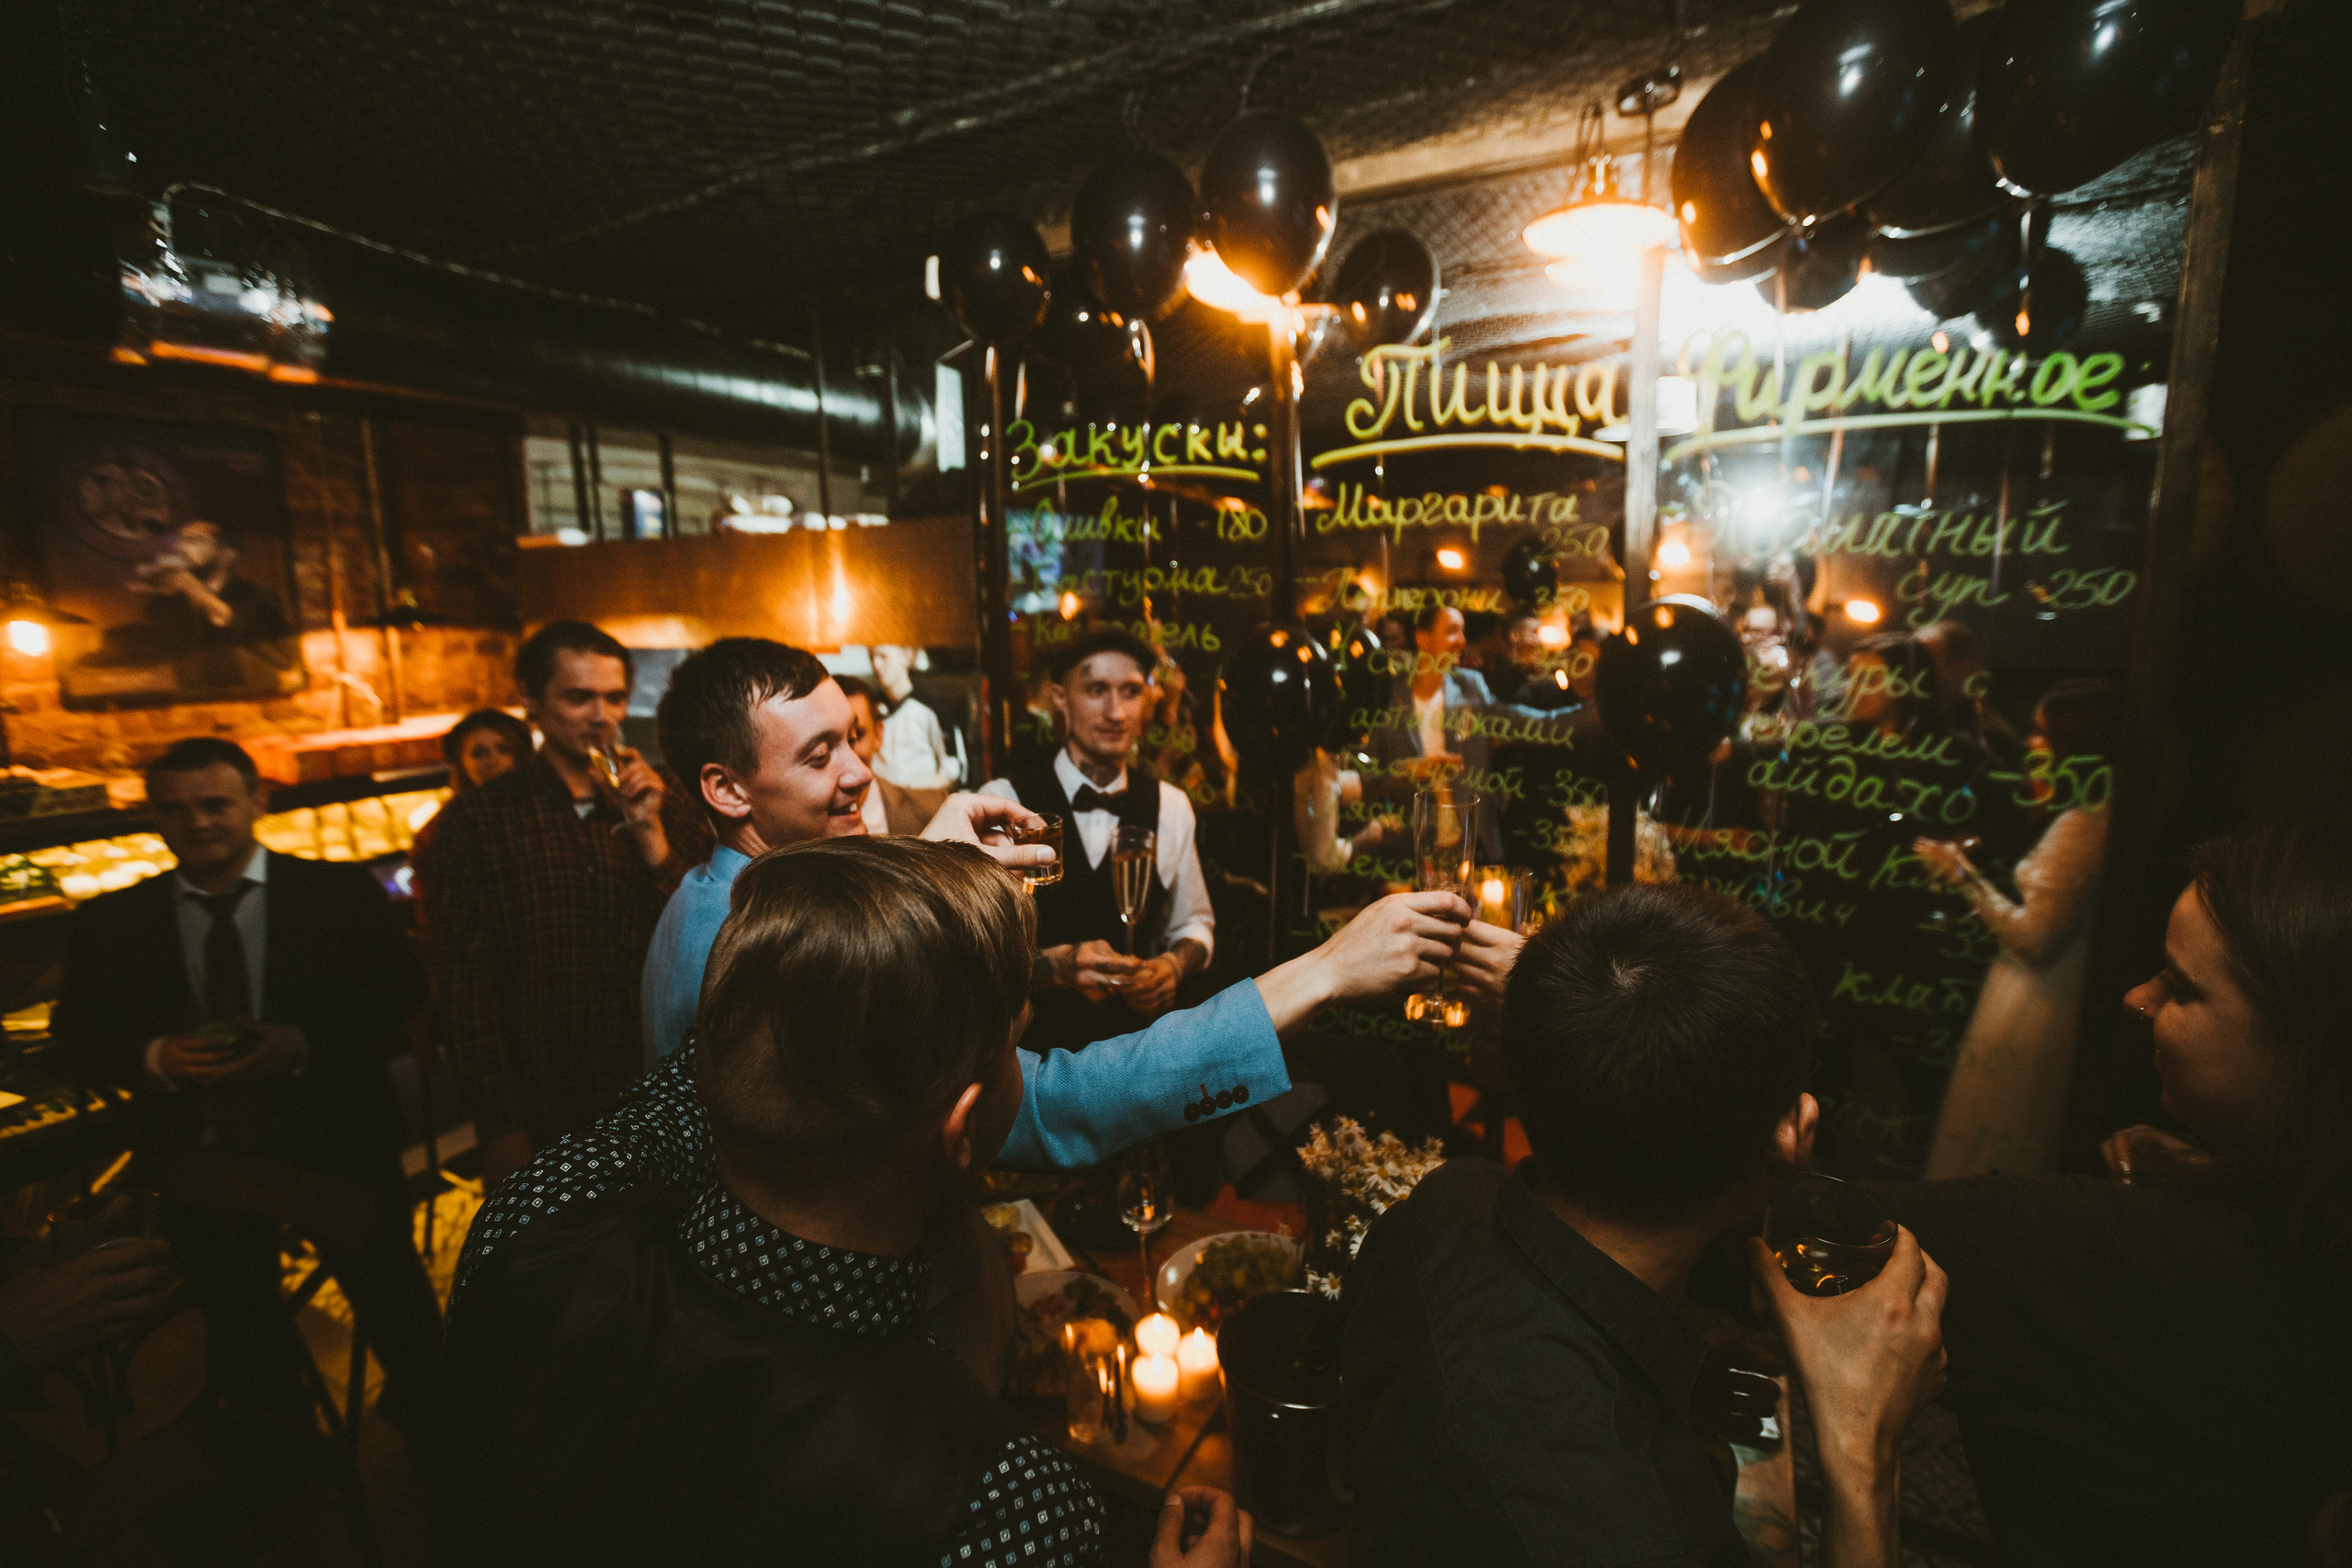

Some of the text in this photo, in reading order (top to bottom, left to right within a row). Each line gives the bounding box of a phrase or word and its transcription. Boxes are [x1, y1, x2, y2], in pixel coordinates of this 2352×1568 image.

[1345, 334, 1631, 439] Пицца
[1006, 420, 1267, 481] Закуски:
[1316, 482, 1580, 545] Маргарита
[1747, 753, 1975, 823] айдахо
